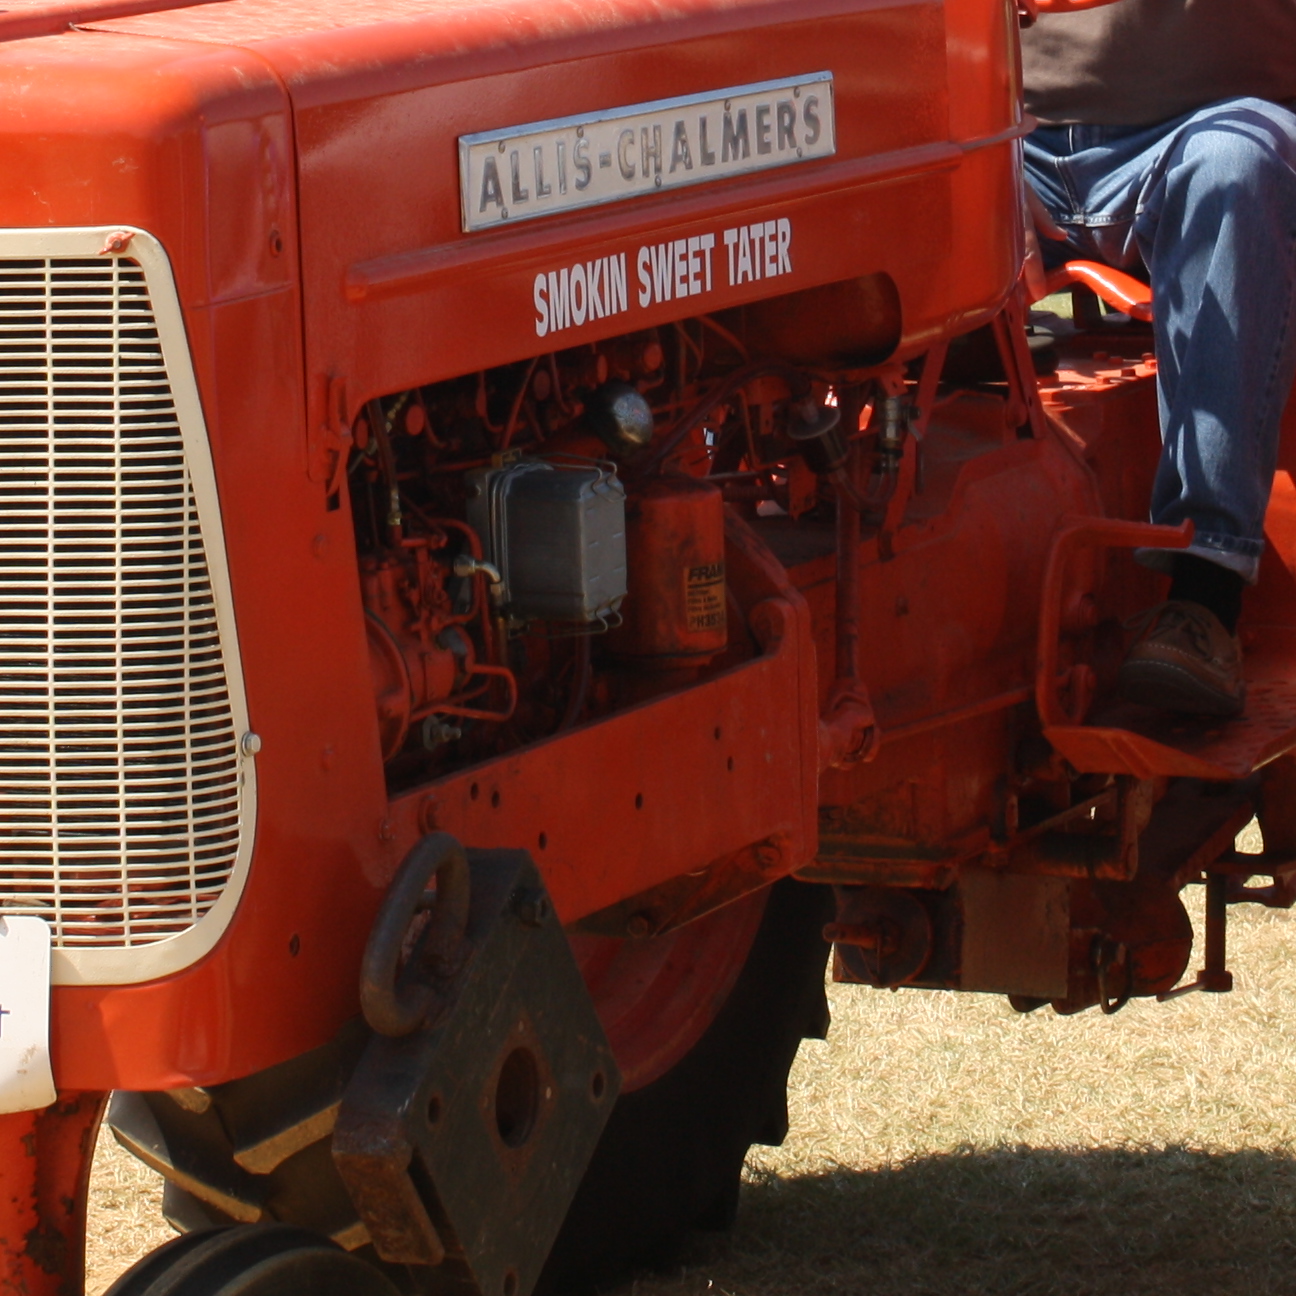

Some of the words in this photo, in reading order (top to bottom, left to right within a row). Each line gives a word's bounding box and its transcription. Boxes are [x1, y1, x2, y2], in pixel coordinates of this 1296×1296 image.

[478, 95, 820, 213] ALLIS-CHALMERS
[533, 252, 628, 338] SMOKIN
[637, 233, 716, 308] SWEET
[723, 217, 792, 286] TATER
